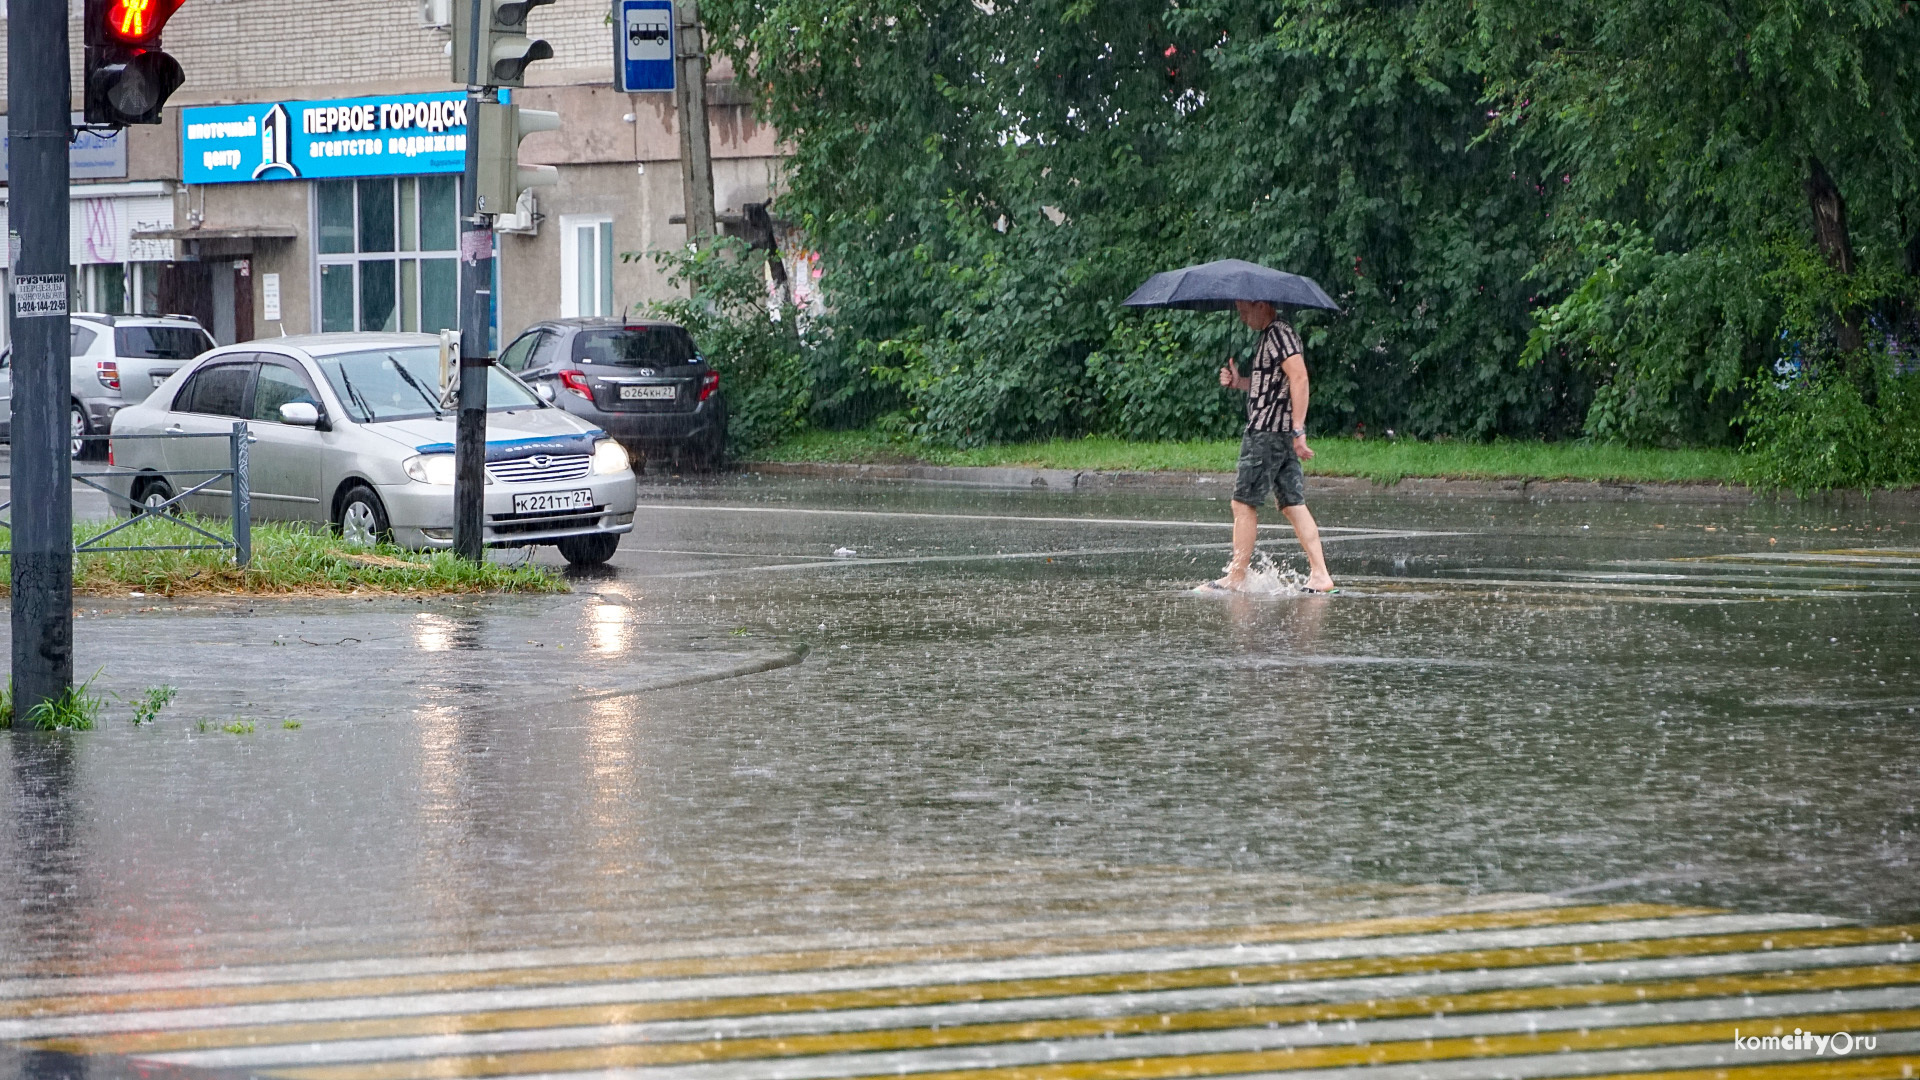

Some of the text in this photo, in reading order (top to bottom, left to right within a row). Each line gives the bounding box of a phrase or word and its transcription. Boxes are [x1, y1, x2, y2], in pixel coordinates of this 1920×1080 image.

[187, 115, 257, 140] ипотечный
[303, 104, 375, 134] ПЕРВОЕ
[309, 138, 383, 157] агентство
[203, 149, 241, 170] центр
[16, 274, 65, 284] ГРУЗЧИКИ
[573, 491, 587, 503] 27
